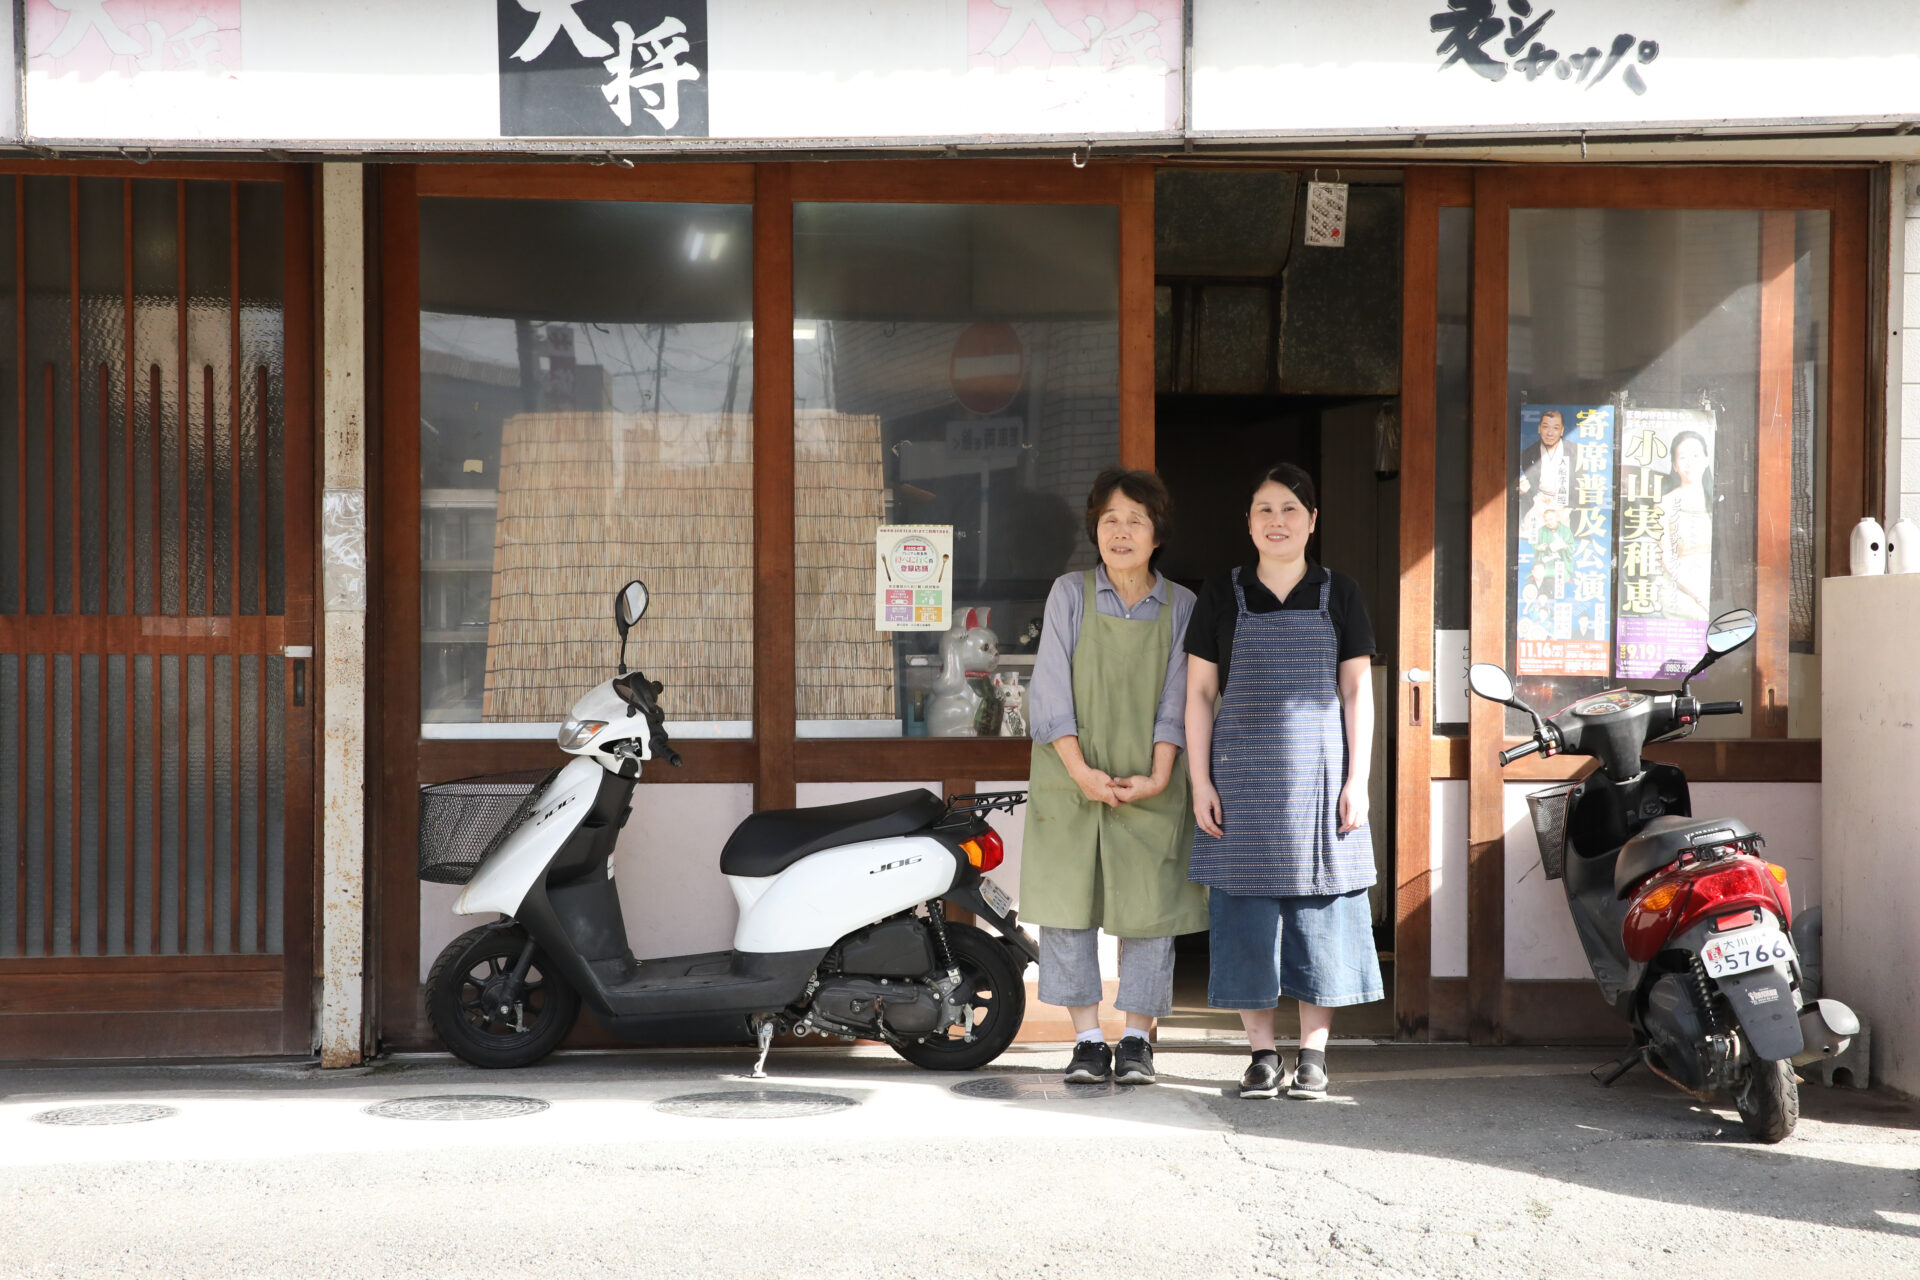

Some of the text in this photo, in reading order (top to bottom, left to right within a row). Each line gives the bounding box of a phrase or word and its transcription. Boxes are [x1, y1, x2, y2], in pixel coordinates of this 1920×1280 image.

[1574, 408, 1610, 602] 寄席普及公演
[1621, 429, 1668, 613] 小山実稚恵
[869, 854, 923, 875] JOG
[1724, 940, 1786, 970] 5766
